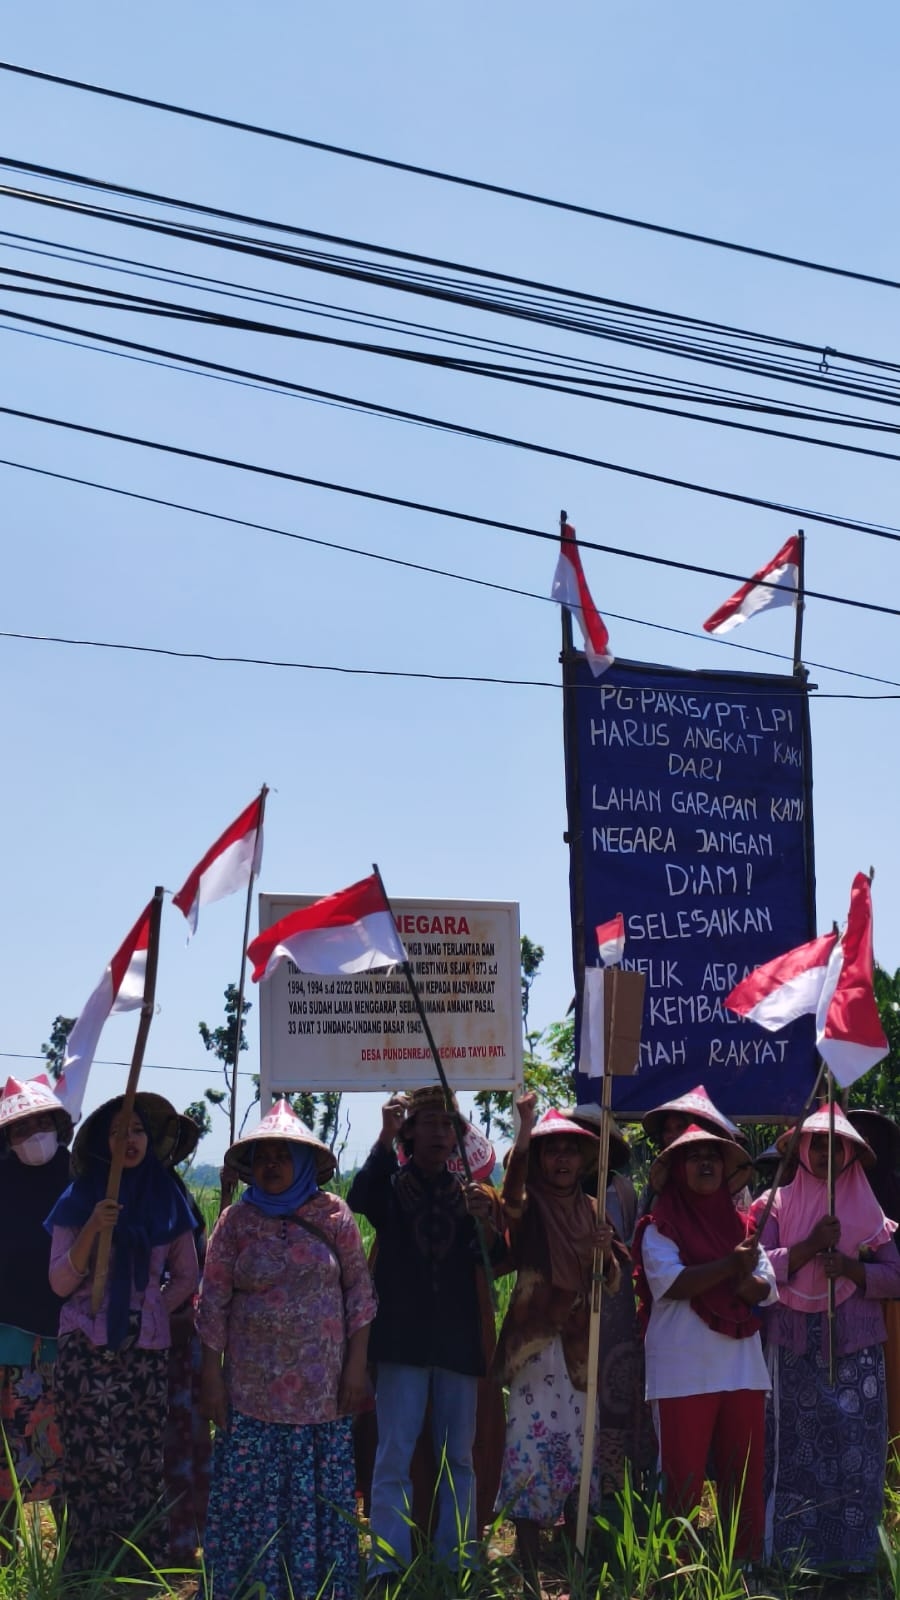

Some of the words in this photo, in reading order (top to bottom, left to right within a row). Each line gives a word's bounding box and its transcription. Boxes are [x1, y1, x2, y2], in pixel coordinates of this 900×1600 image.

[590, 719, 670, 747] HARUS
[683, 727, 764, 757] ANGKAT
[669, 753, 722, 782] DARI
[592, 784, 661, 813] LAHAN
[672, 791, 758, 820] GARAPAN
[770, 797, 804, 822] KAMI
[592, 826, 676, 853] NEGARA
[696, 829, 773, 856] JANGAN
[394, 915, 470, 935] NEGARA
[628, 906, 773, 940] SELESAIKAN
[423, 943, 441, 956] YANG
[443, 943, 480, 956] TERLANTAR
[482, 943, 495, 956] DAN
[416, 962, 448, 975] MESTINYA
[450, 962, 470, 975] SEJAK
[472, 962, 487, 975] 1973
[288, 980, 305, 997] 1994,
[307, 980, 323, 994] 1994
[336, 981, 353, 994] 2022
[354, 981, 373, 994] GUNA
[426, 981, 450, 994] KEPADA
[452, 980, 495, 994] MASYARAKAT
[289, 1000, 307, 1015] YANG
[309, 1000, 333, 1014] SUDAH
[334, 1000, 353, 1014] LAMA
[355, 1000, 398, 1016] MENGGARAP,
[447, 1000, 473, 1013] AMANAT
[475, 999, 495, 1013] PASAL
[288, 1020, 296, 1035] 33
[298, 1020, 315, 1034] AYAT
[316, 1020, 321, 1034] 3
[323, 1020, 381, 1034] UNDANG-UNDANG
[383, 1020, 405, 1034] DASAR
[361, 1048, 381, 1061] DESA
[468, 1046, 487, 1058] TAYU
[488, 1045, 506, 1057] PATI.
[639, 1040, 686, 1068] NAH
[709, 1039, 789, 1067] RAKYAT
